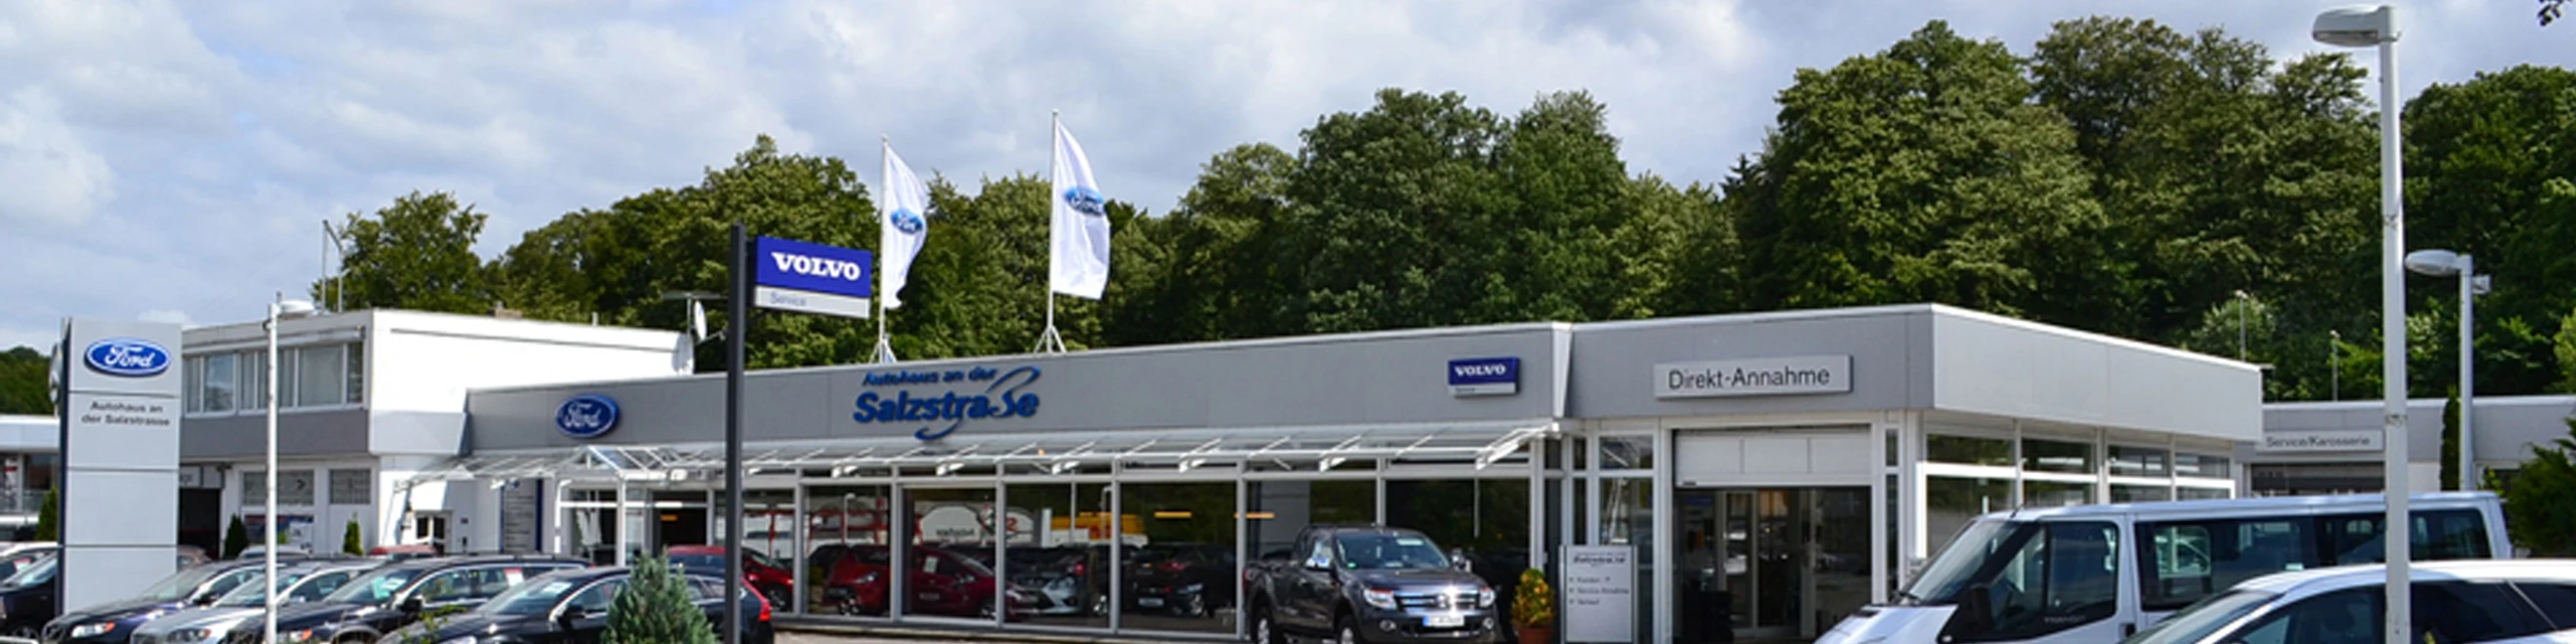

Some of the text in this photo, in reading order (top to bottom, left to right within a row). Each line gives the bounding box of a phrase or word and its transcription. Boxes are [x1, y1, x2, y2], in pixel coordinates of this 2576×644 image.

[771, 251, 861, 281] VOLVO
[104, 344, 156, 367] Ford
[863, 366, 997, 386] Autohaus an der
[1454, 363, 1507, 377] VOLVO
[1668, 365, 1831, 390] Direkt-Annahme
[91, 401, 145, 412] Autohaus
[564, 402, 602, 427] Ford
[81, 414, 170, 426] der Salzstrasse
